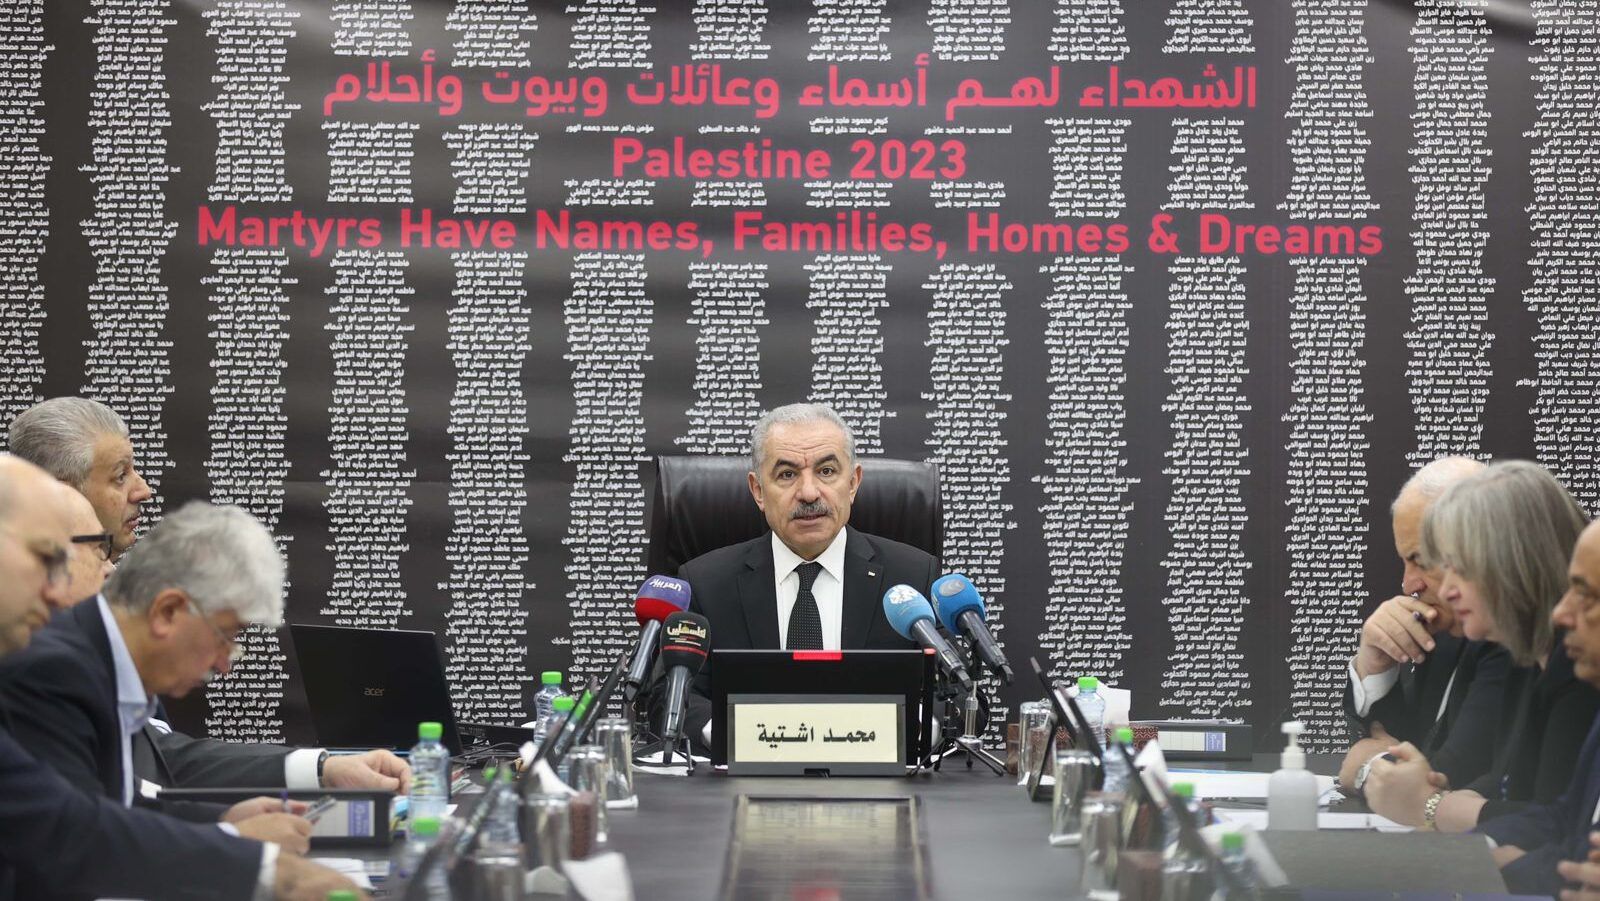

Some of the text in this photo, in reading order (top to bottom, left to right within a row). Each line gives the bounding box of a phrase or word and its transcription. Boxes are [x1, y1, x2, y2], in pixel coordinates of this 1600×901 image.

[324, 51, 462, 115] وأحلام
[482, 72, 608, 116] وبيوت
[627, 64, 779, 118] وعائلات
[800, 54, 927, 106] أسماء
[1080, 65, 1256, 108] الشهداء
[614, 137, 965, 179] Palestine 2023
[199, 206, 1382, 258] Martyrs Have Names, Families, Homes & Dreams
[364, 687, 384, 696] acer
[757, 723, 876, 748] محمد اشتية
